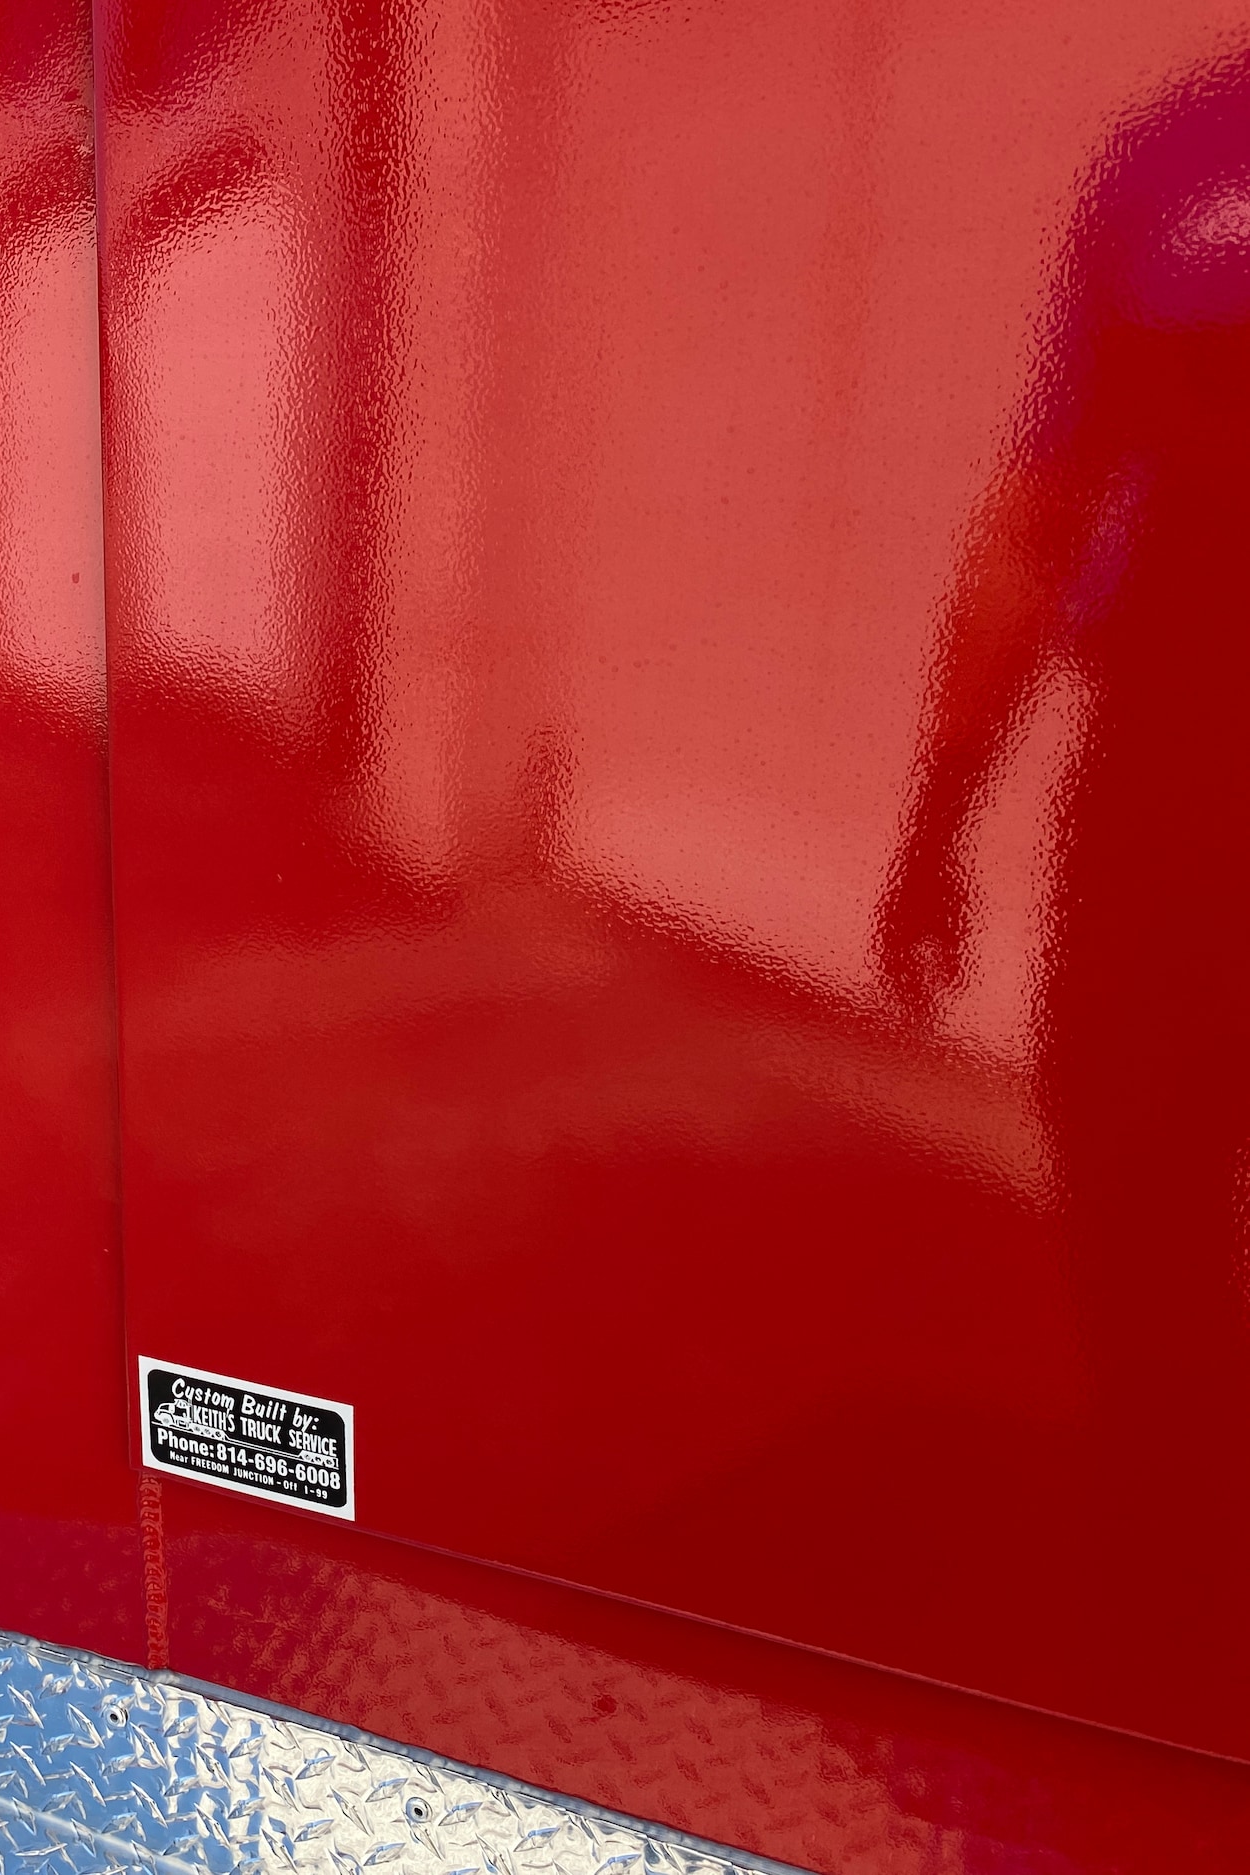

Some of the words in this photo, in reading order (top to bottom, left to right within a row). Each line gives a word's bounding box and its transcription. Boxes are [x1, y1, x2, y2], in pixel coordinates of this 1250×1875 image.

[171, 1378, 235, 1410] Custom
[241, 1395, 287, 1422] Built
[292, 1407, 320, 1432] by:
[193, 1405, 236, 1433] KEITH'S
[240, 1417, 281, 1444] TRUCK
[288, 1430, 337, 1457] SERVICE
[169, 1450, 189, 1464] Near
[191, 1456, 230, 1475] FREEDOM
[233, 1468, 274, 1486] JUNCTION
[283, 1480, 298, 1491] Off
